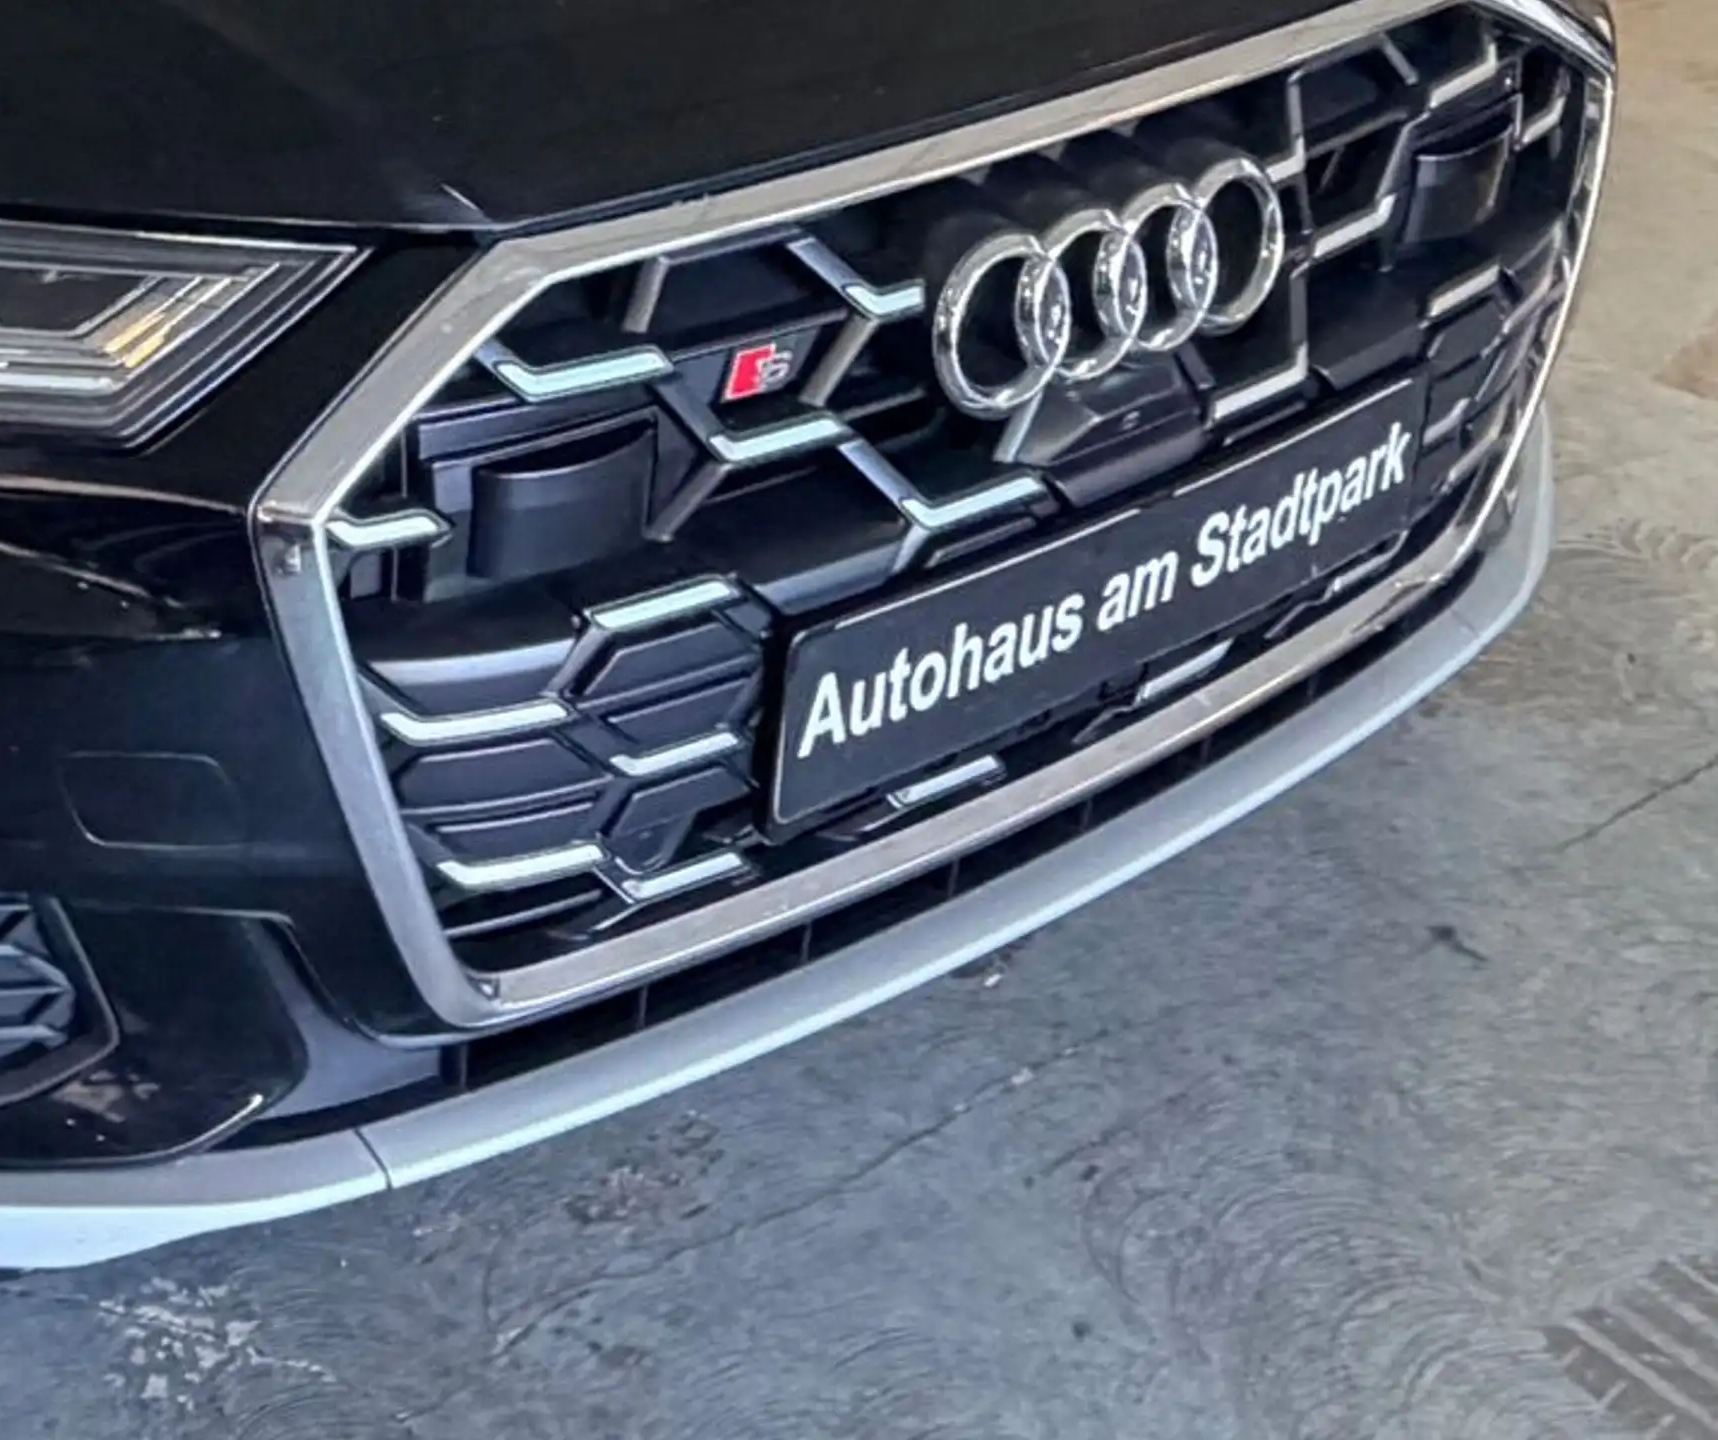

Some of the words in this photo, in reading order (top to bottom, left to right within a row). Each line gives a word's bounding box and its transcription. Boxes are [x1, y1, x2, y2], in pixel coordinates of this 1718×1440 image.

[796, 586, 1084, 758] Autohaus
[1096, 555, 1179, 632] am
[1190, 421, 1415, 589] Stadtpark
